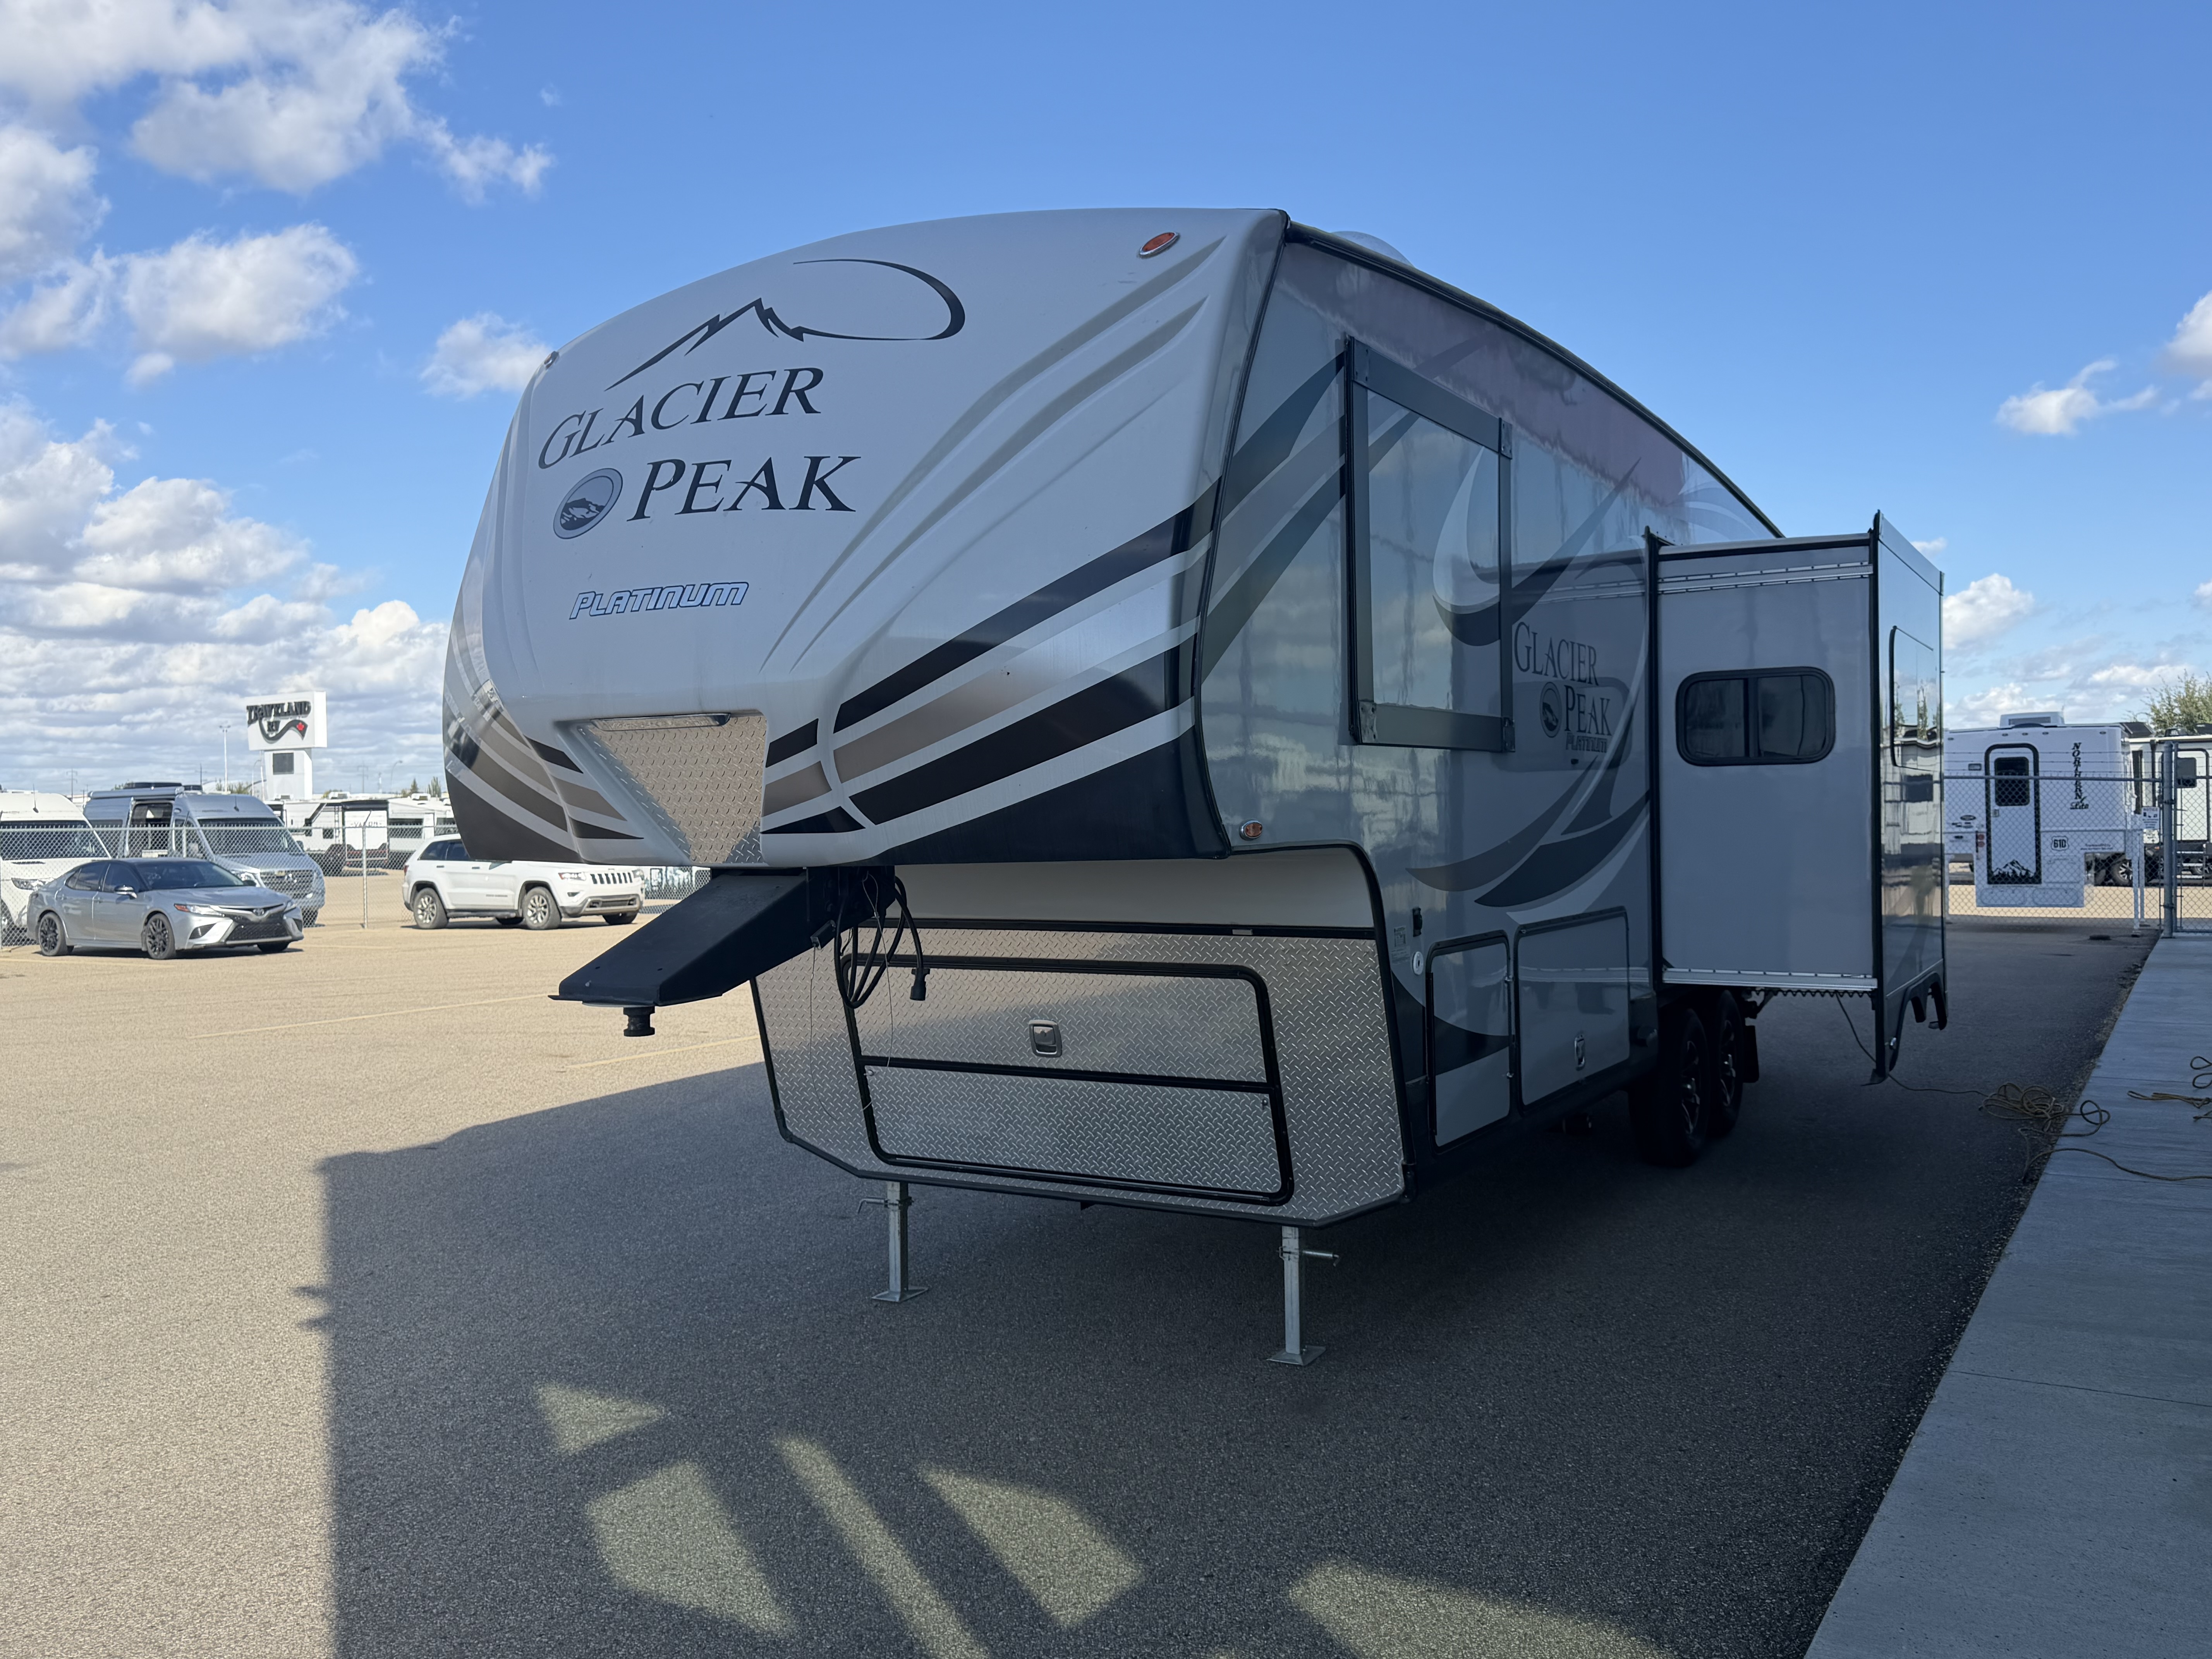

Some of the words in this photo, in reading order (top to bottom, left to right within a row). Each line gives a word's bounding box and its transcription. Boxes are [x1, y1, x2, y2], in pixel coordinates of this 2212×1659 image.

[538, 368, 824, 469] GLACIER
[627, 455, 862, 522] PEAK
[569, 582, 749, 620] PLATINUM
[1514, 622, 1599, 686] GLACIER
[246, 701, 311, 725] TRAVELAND
[267, 721, 280, 732] RV
[1564, 684, 1612, 737] PEAK
[2072, 742, 2082, 800] NORTHERN
[2053, 839, 2066, 848] 610
